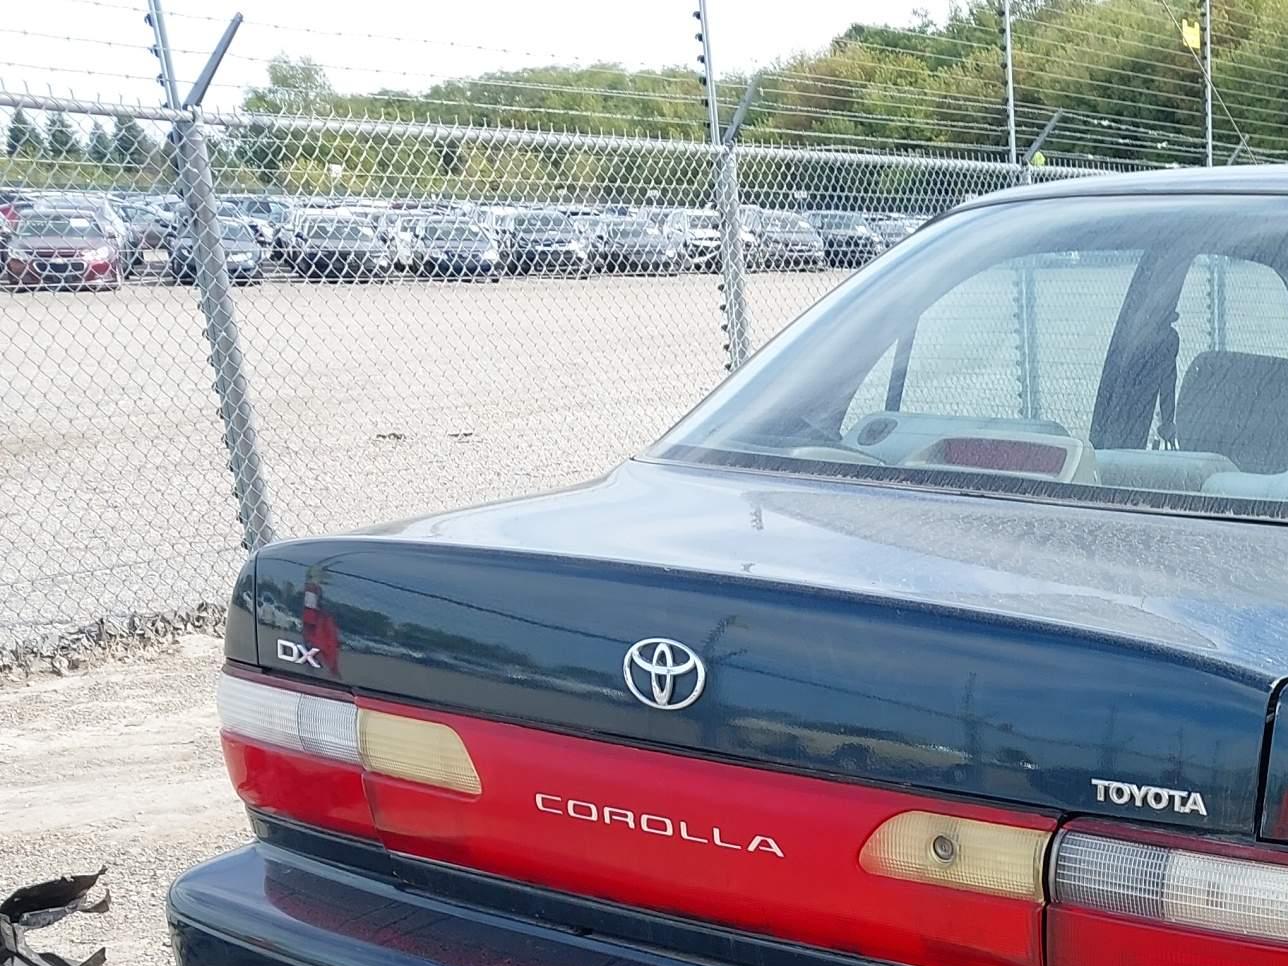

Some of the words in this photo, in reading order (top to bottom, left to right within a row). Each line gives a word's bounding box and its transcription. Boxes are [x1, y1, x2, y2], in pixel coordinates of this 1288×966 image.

[277, 639, 321, 668] DX
[1091, 778, 1208, 816] TOYOTA
[535, 793, 784, 858] COROLLA
